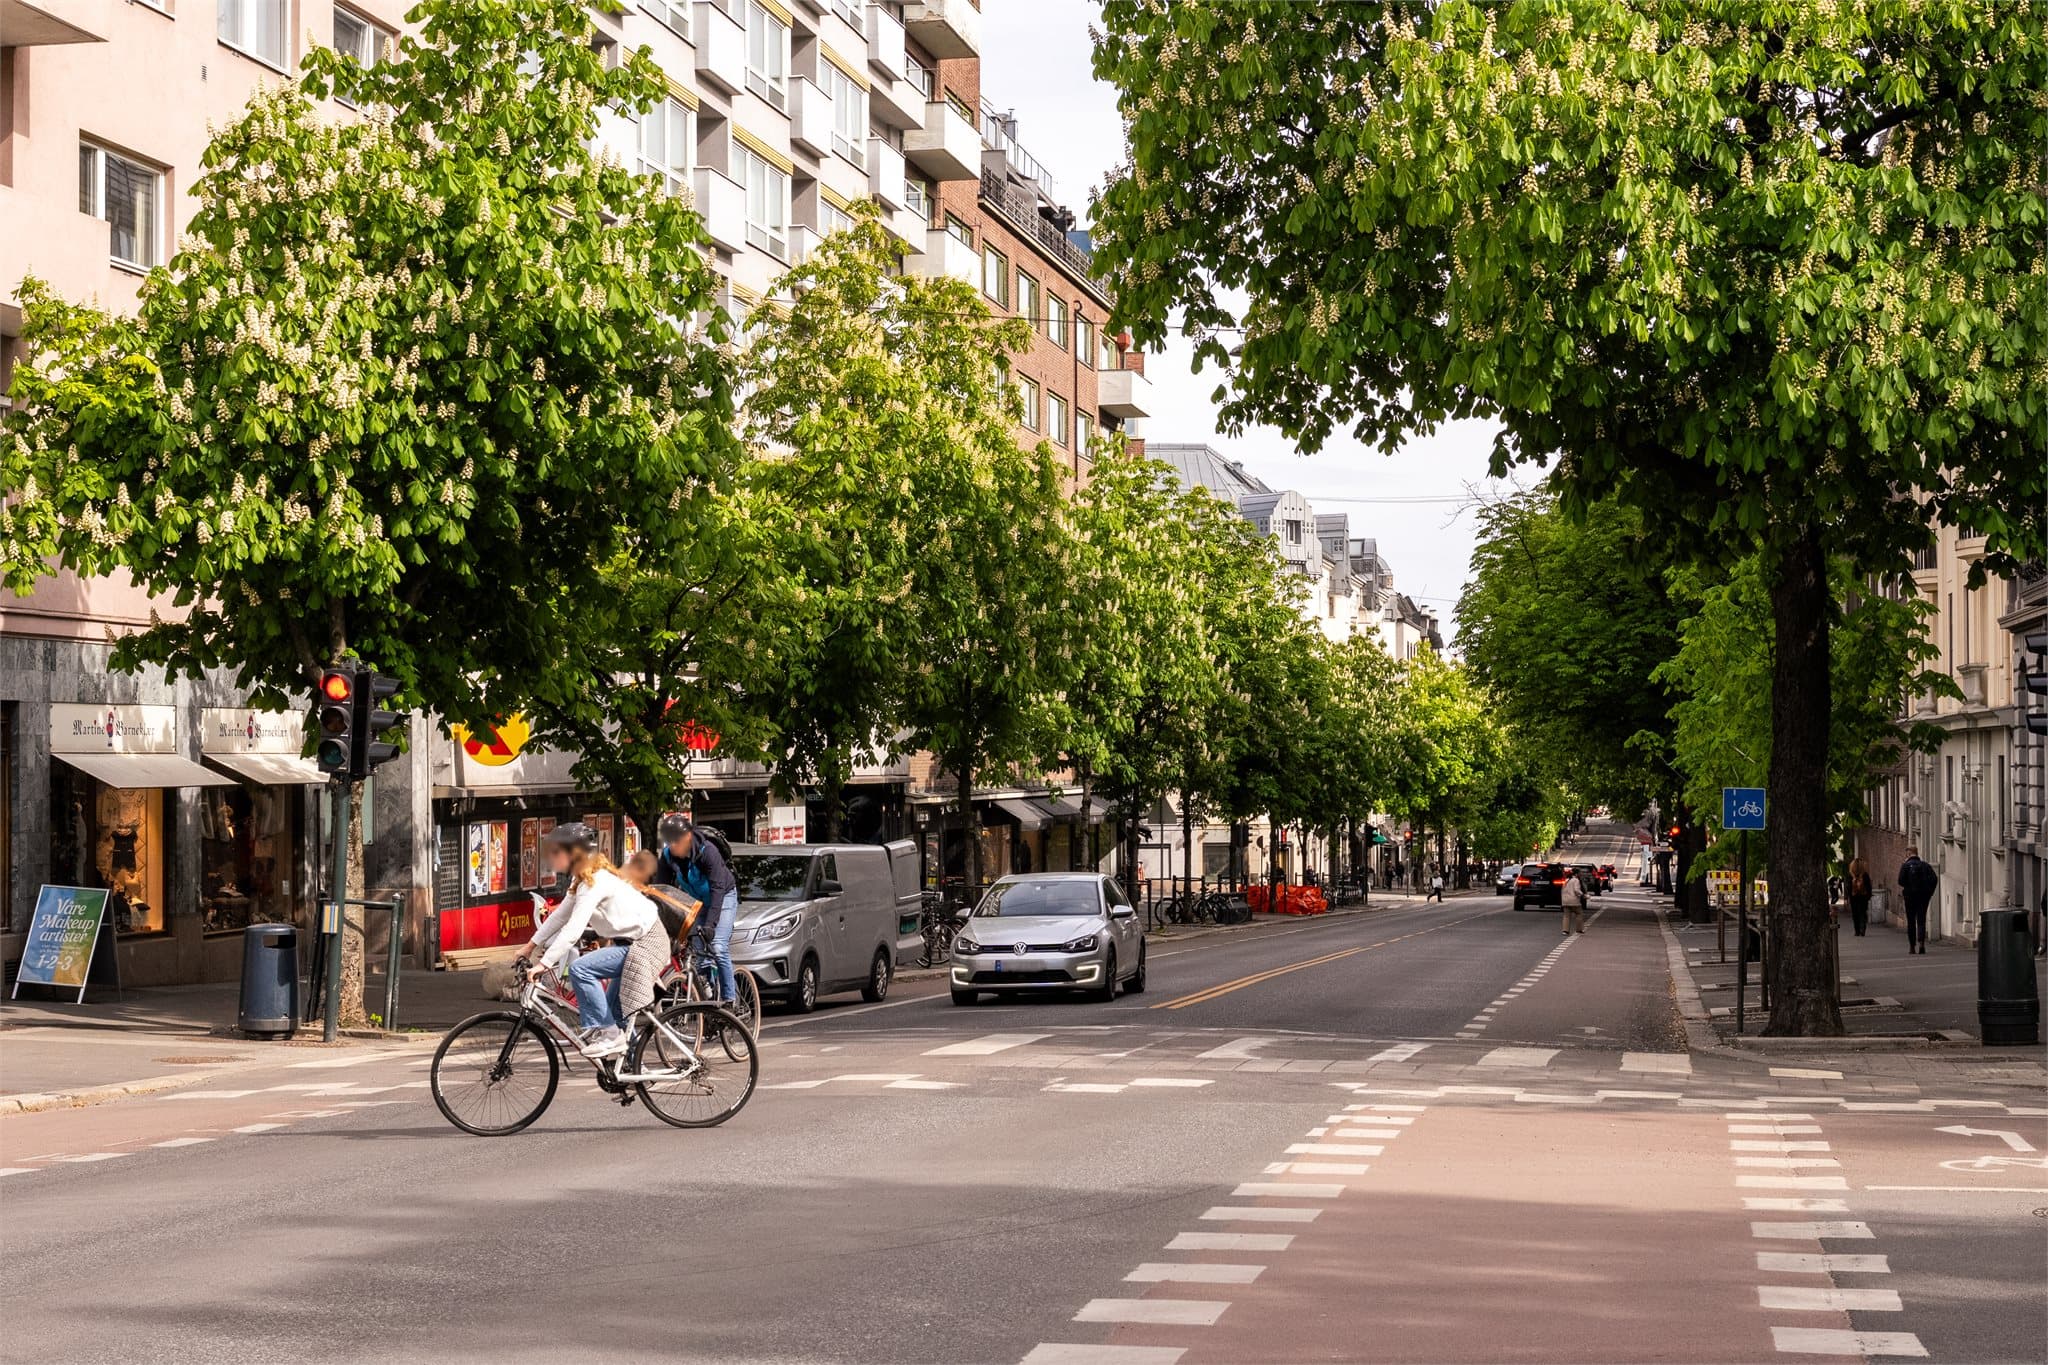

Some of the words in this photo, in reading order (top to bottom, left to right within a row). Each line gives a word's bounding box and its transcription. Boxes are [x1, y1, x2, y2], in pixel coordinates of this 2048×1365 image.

[72, 719, 105, 736] Martine
[56, 897, 87, 915] Våre
[38, 914, 95, 933] Makeup
[510, 914, 530, 929] EXTRA
[39, 930, 88, 943] artister
[35, 954, 73, 971] 1-2-3
